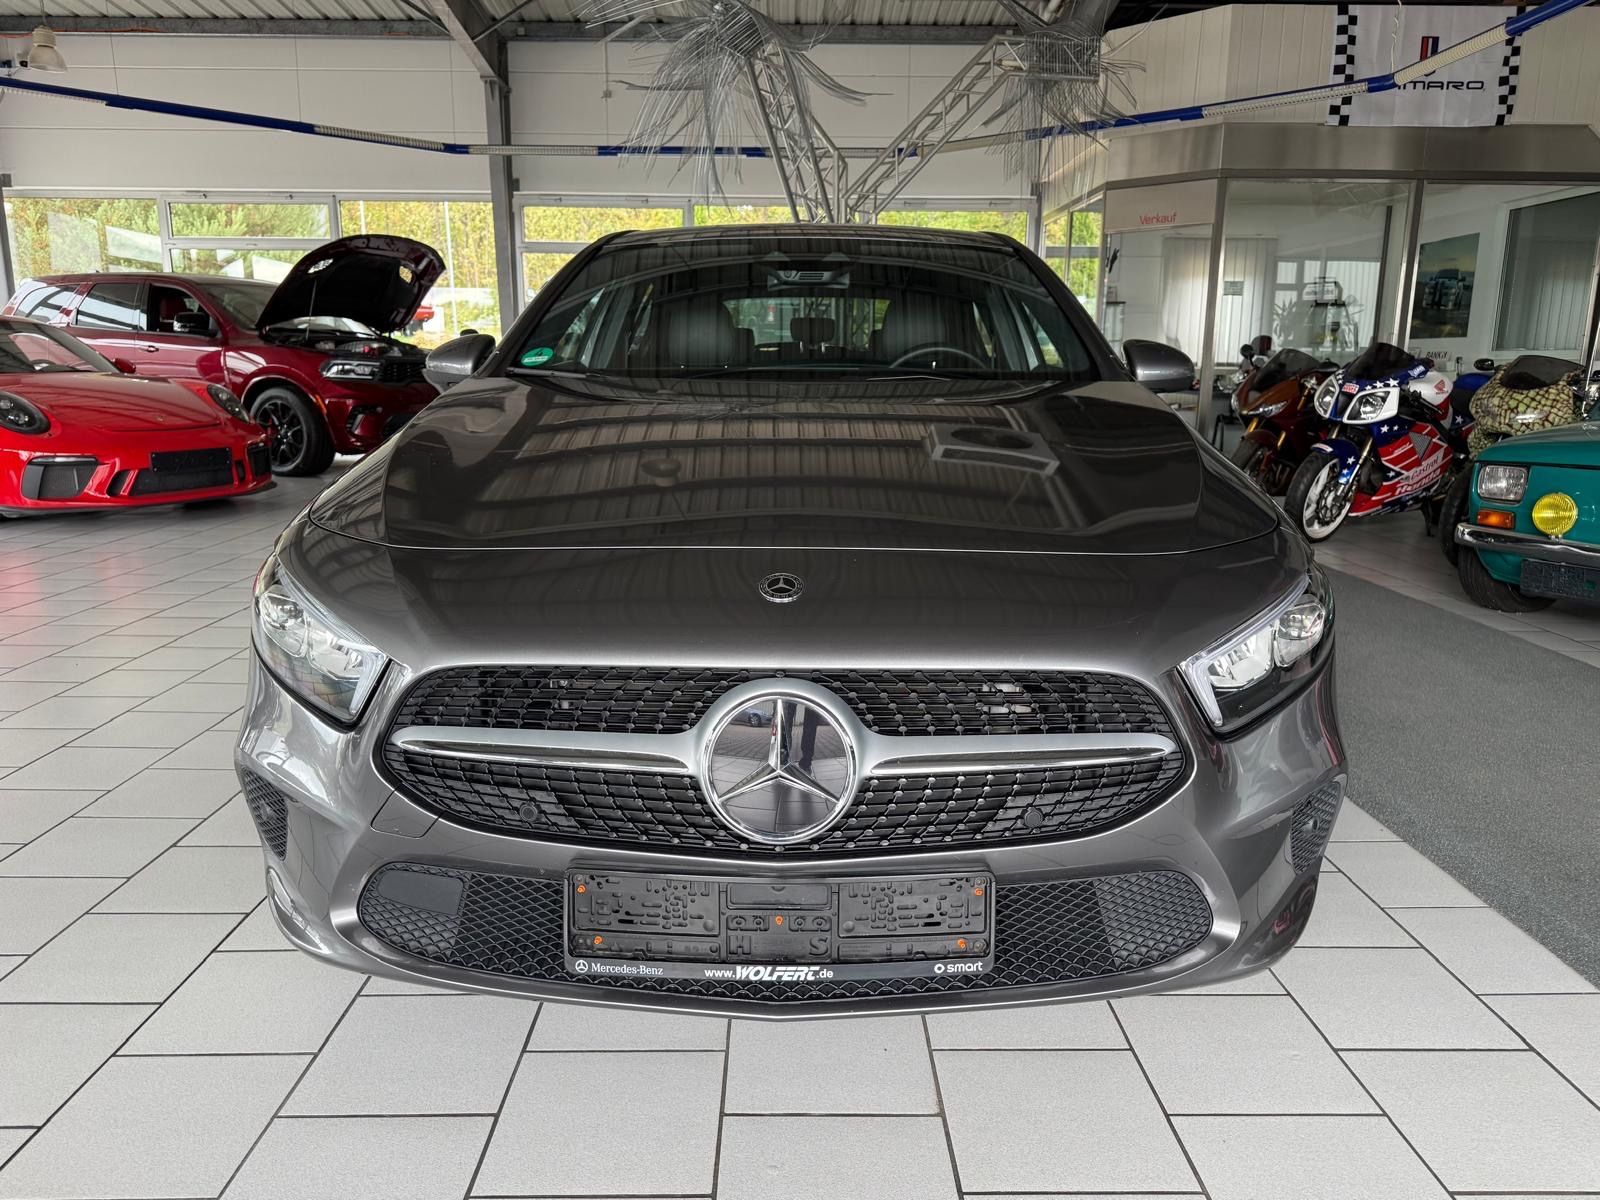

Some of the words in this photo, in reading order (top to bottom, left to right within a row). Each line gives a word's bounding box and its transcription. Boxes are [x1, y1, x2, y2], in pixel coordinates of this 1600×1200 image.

[1139, 211, 1177, 225] Verkauf
[1394, 468, 1441, 496] Honda
[808, 936, 829, 957] S
[591, 962, 664, 976] Mercedes-Benz
[946, 960, 983, 973] smart
